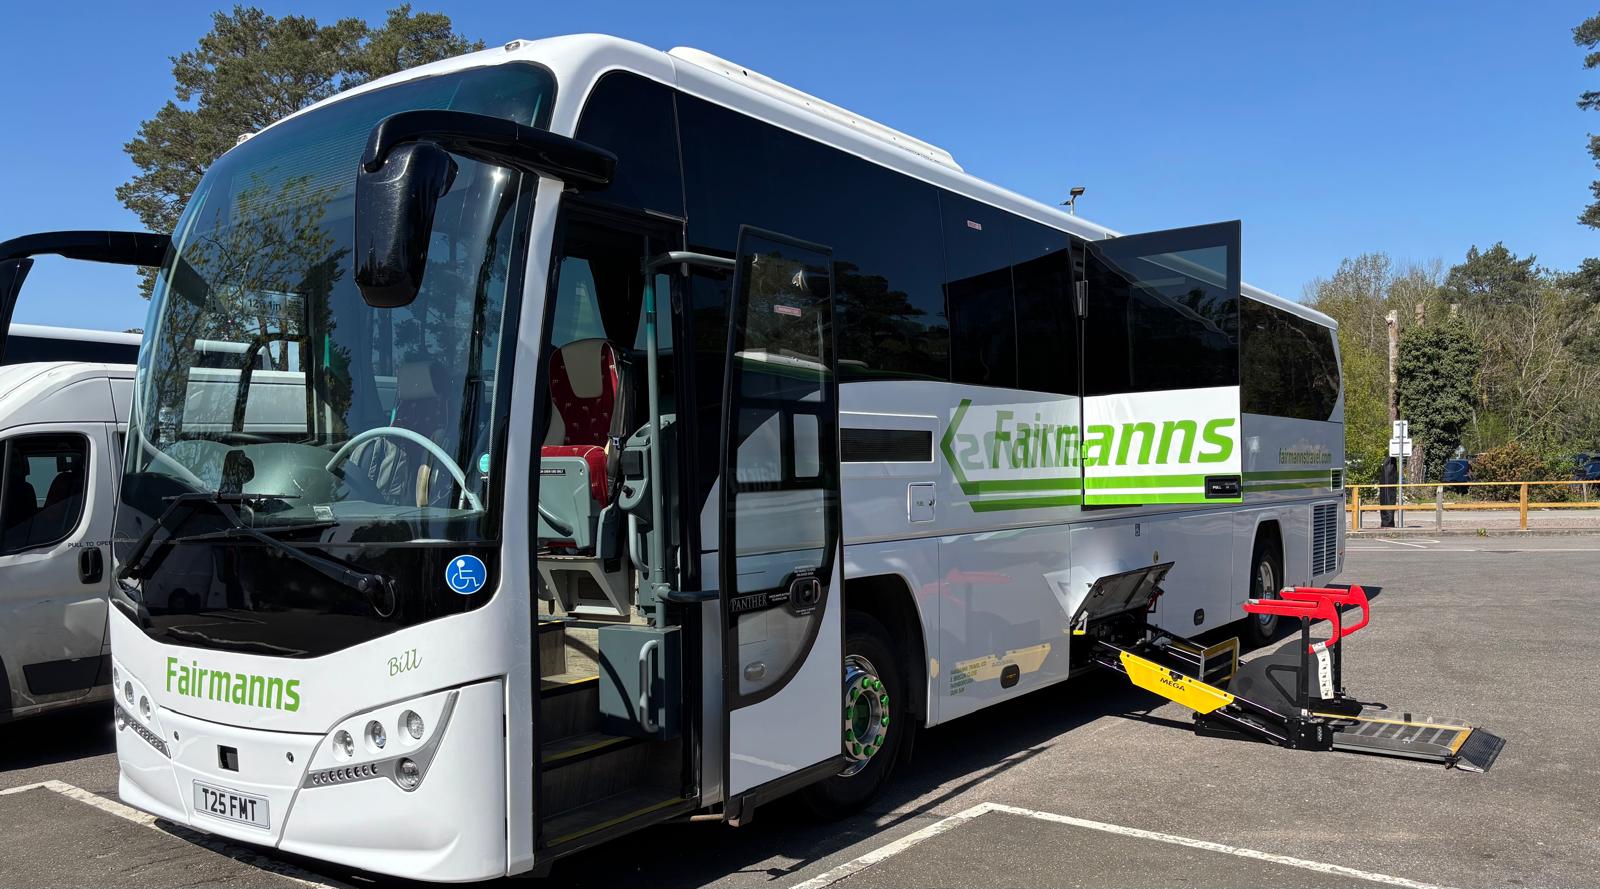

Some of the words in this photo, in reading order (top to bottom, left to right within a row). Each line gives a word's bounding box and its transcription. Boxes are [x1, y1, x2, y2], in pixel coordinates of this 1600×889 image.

[991, 410, 1236, 470] Fairmanns
[1278, 448, 1332, 465] fairmannstravel.com
[729, 594, 767, 612] PANTHER
[387, 648, 422, 677] Bill
[166, 656, 301, 712] Fairmanns
[1160, 677, 1185, 691] MEGA
[202, 787, 227, 815] T25
[229, 795, 257, 822] FMT
